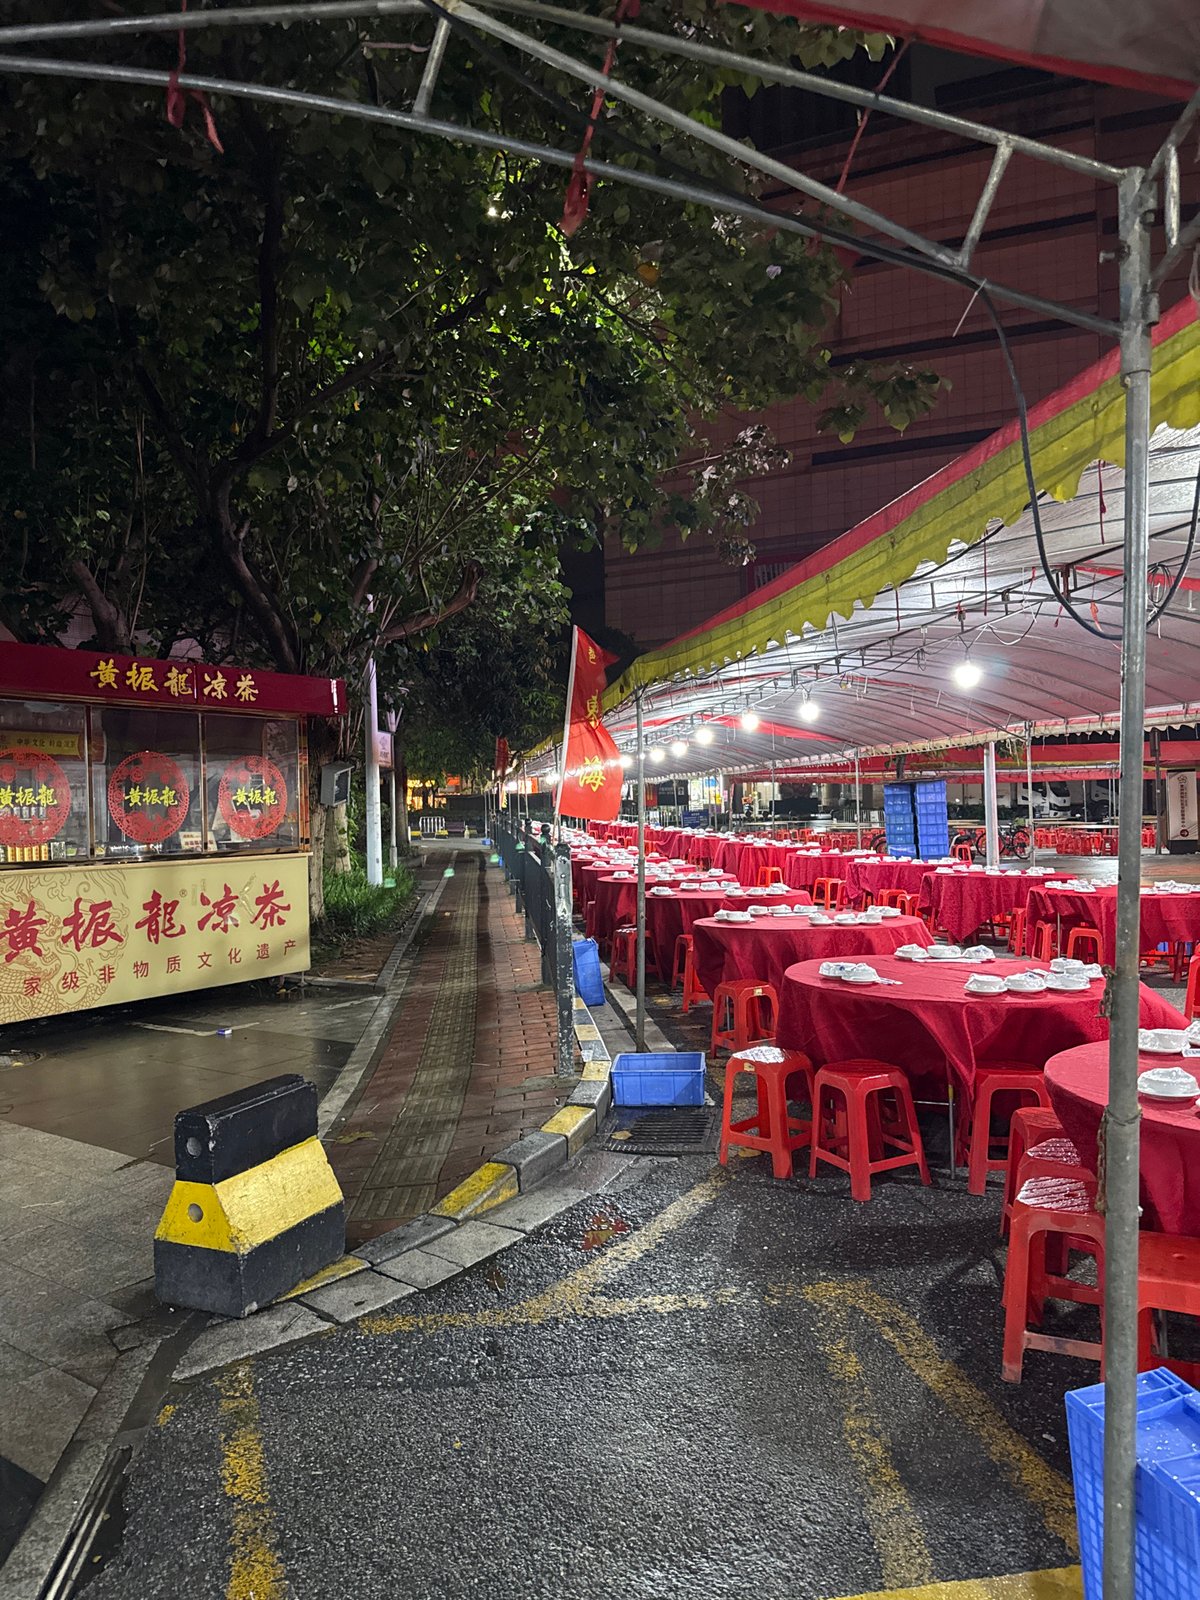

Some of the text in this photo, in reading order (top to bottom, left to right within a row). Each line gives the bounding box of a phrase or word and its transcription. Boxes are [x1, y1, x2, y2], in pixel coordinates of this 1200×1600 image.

[23, 939, 297, 997] 家级非物质文化遗产
